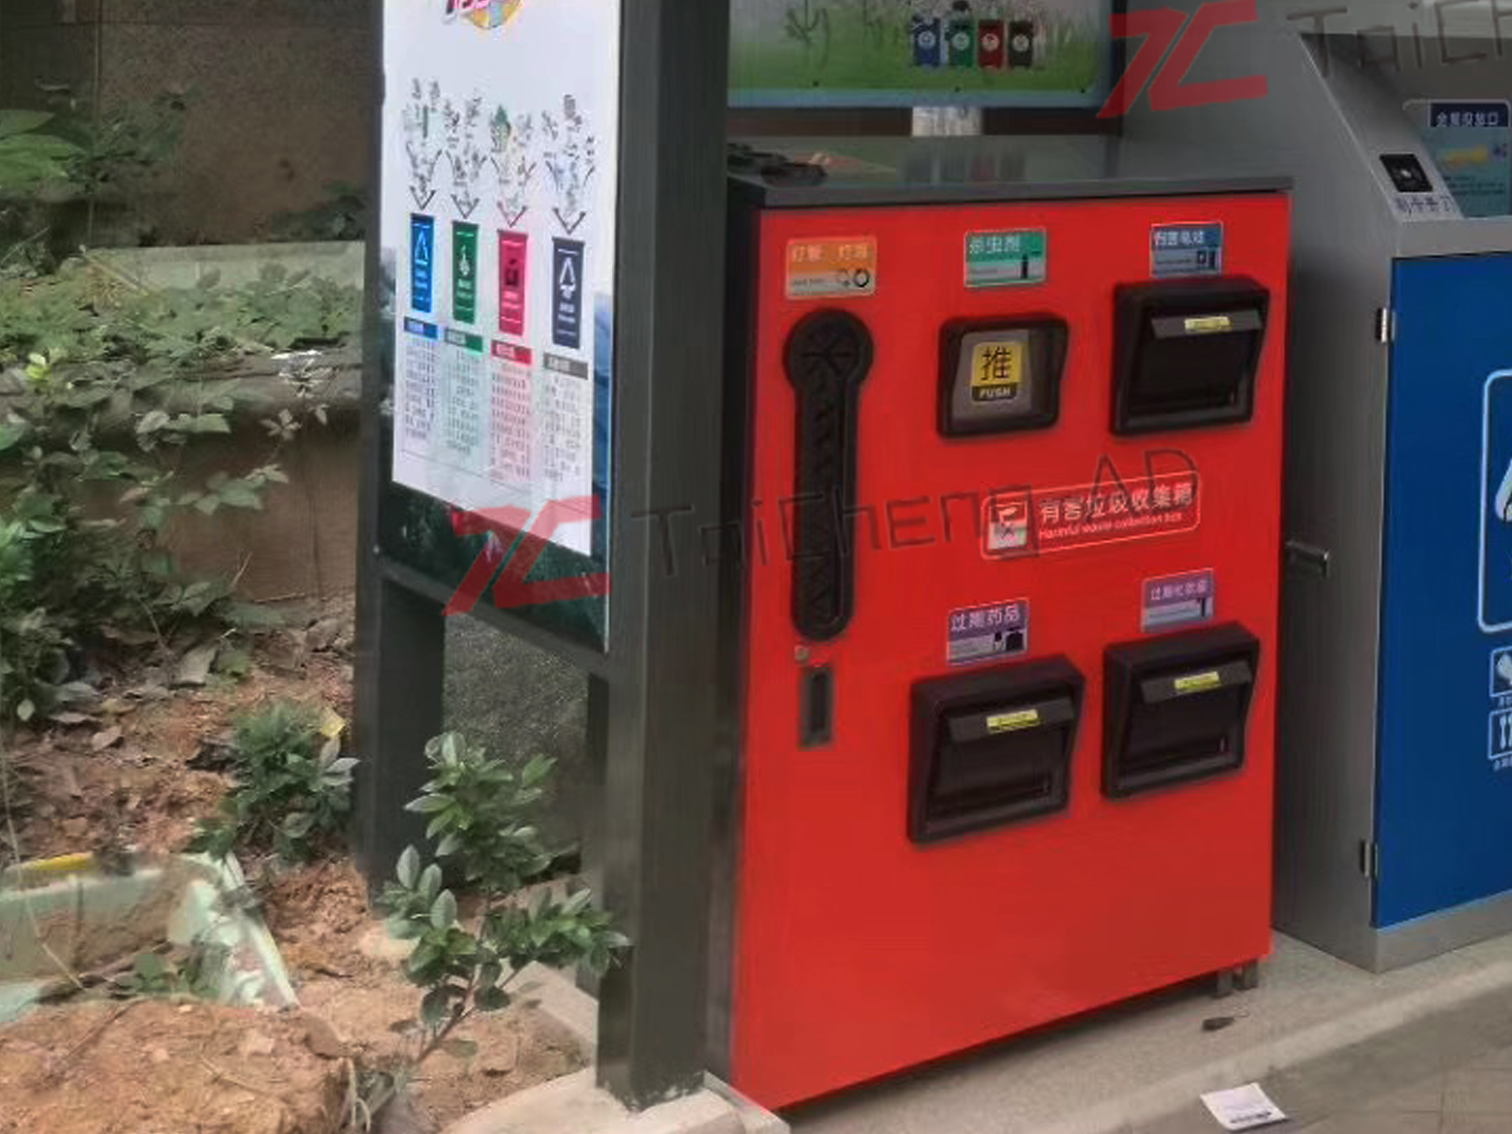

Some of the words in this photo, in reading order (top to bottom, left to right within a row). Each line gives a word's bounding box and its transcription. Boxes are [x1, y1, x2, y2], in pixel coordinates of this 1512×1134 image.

[981, 345, 1012, 382] 推
[979, 386, 1012, 400] PUSH
[950, 603, 1020, 631] 过期药品
